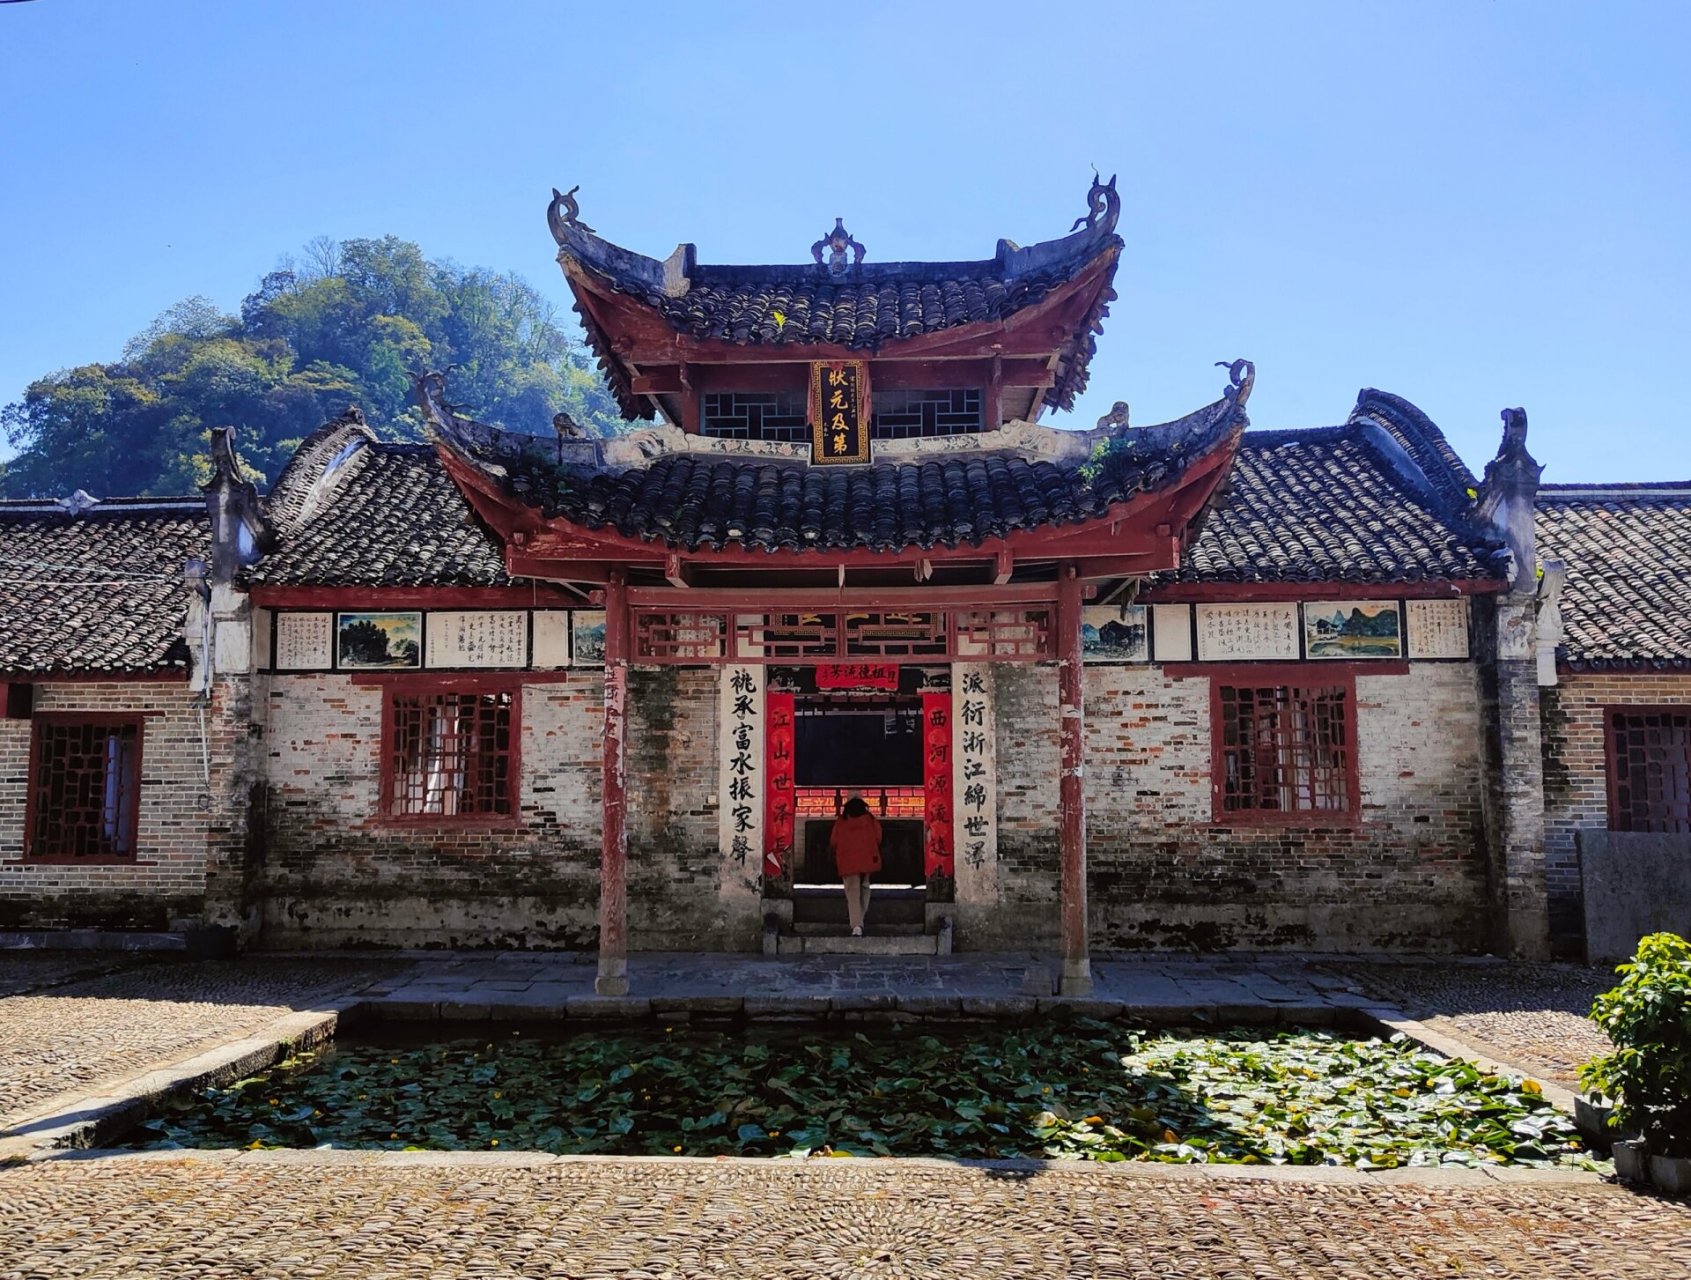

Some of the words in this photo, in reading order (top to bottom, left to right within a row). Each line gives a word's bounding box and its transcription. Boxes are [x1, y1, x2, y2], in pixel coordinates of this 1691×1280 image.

[961, 672, 989, 871] 派衍浙江綿世澤
